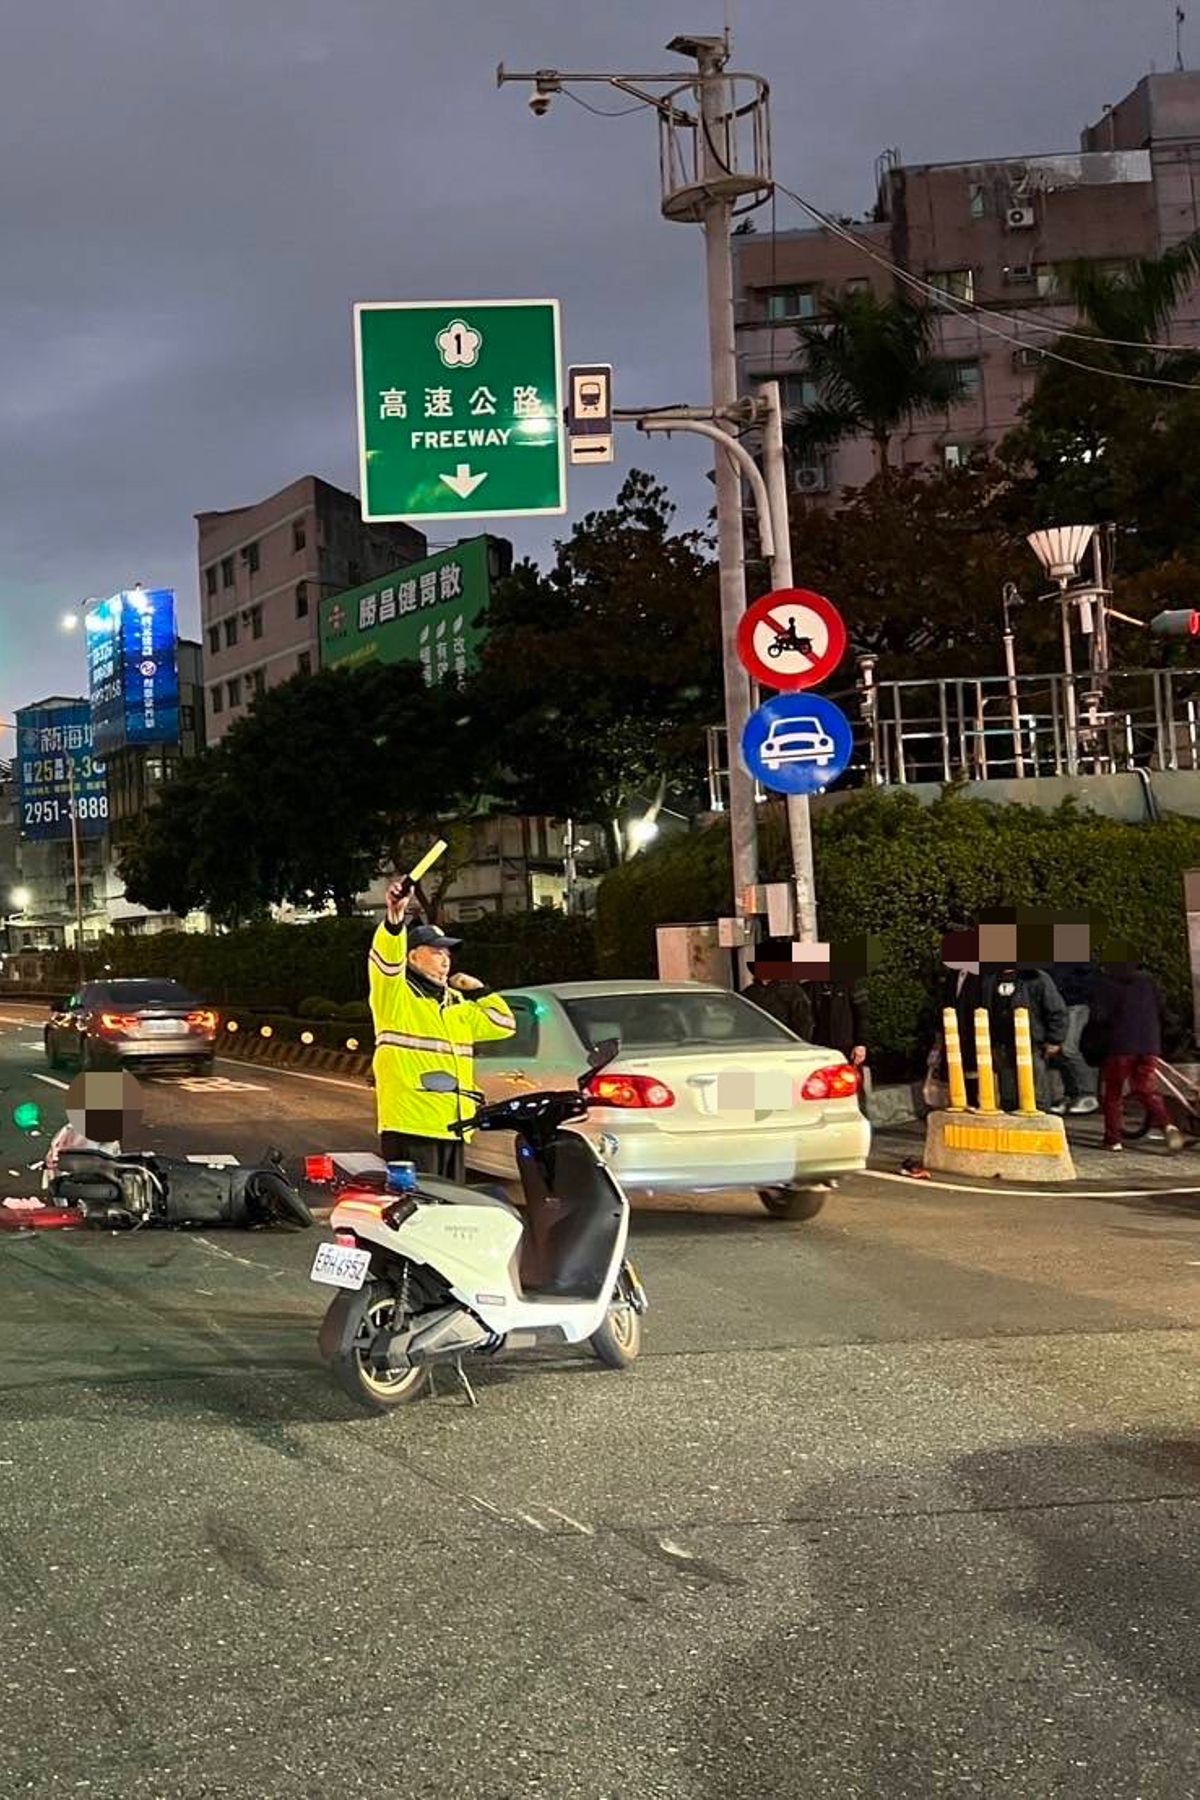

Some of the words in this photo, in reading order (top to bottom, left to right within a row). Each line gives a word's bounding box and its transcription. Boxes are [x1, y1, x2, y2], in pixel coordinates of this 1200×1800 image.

[454, 333, 462, 355] 1
[379, 385, 542, 419] 高速公路
[411, 429, 511, 449] FREEWAY
[359, 562, 462, 630] 勝昌健胃散
